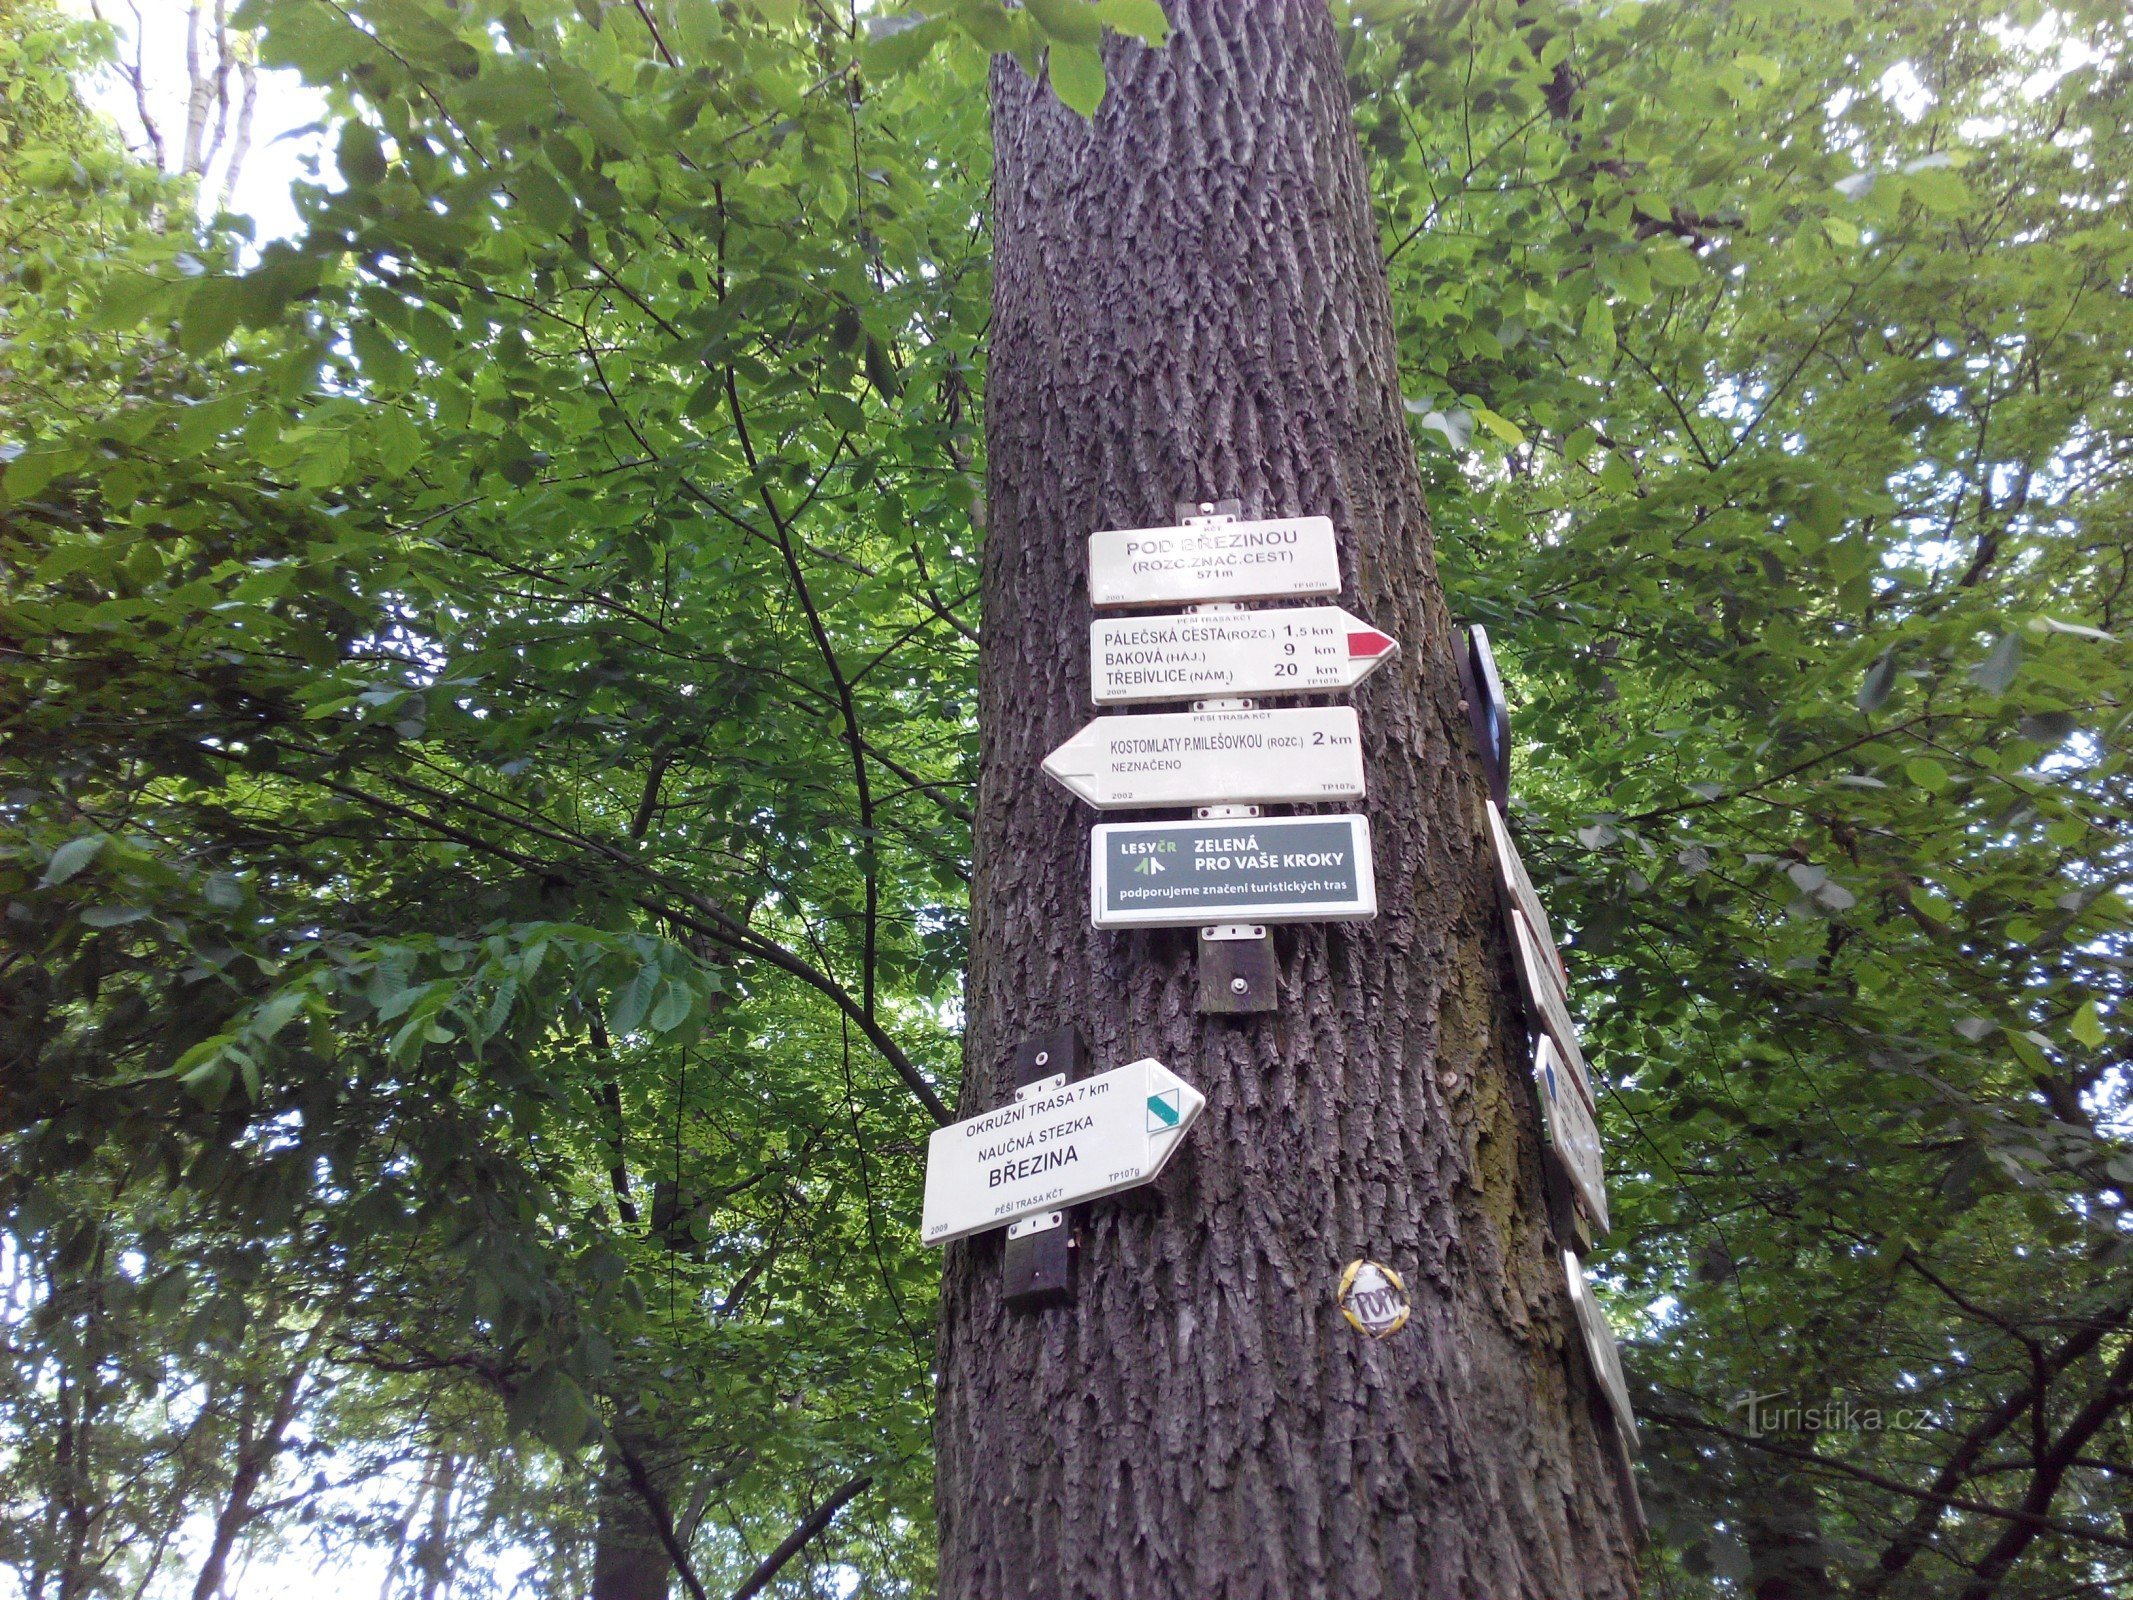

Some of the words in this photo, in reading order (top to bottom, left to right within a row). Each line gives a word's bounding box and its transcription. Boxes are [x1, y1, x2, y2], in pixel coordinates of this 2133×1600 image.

[1127, 539, 1173, 556] POD
[1181, 530, 1298, 550] BŘEZINOU
[1105, 625, 1178, 646] PÁLEČSKÁ
[1311, 626, 1334, 635] km
[1105, 650, 1164, 665] BAKOVÁ
[1284, 643, 1295, 656] 9
[1314, 645, 1336, 655] km
[1107, 669, 1187, 685] TŘEBÍVLICE
[1274, 664, 1298, 676] 20
[1316, 665, 1338, 674] km
[1111, 736, 1182, 754] KOSTOMLATY
[1267, 735, 1304, 750] (ROZC.)
[1312, 731, 1324, 745] 2
[1330, 734, 1352, 745] km
[1112, 758, 1182, 772] NEZNAČENO
[1195, 834, 1259, 853] ZELENÁ
[1195, 856, 1229, 871] PRO
[1234, 851, 1279, 870] VAŠE
[1284, 853, 1344, 868] KROKY
[1120, 885, 1199, 900] podporujeme
[1203, 882, 1248, 896] značení
[1251, 880, 1321, 893] turistických
[1324, 879, 1347, 890] tras
[966, 1104, 1025, 1137] OKRUŽNÍ
[1029, 1093, 1075, 1116] TRASA
[1078, 1087, 1085, 1100] 7
[1089, 1082, 1109, 1098] km
[978, 1131, 1035, 1163] NAUČNÁ
[1039, 1115, 1093, 1143] STEZKA
[989, 1145, 1078, 1187] BŘEZINA
[1109, 1168, 1140, 1182] TP107g
[994, 1202, 1014, 1216] PĚŠÍ
[1016, 1195, 1044, 1210] TRASA
[1046, 1189, 1064, 1202] KČT
[930, 1223, 948, 1235] 2009
